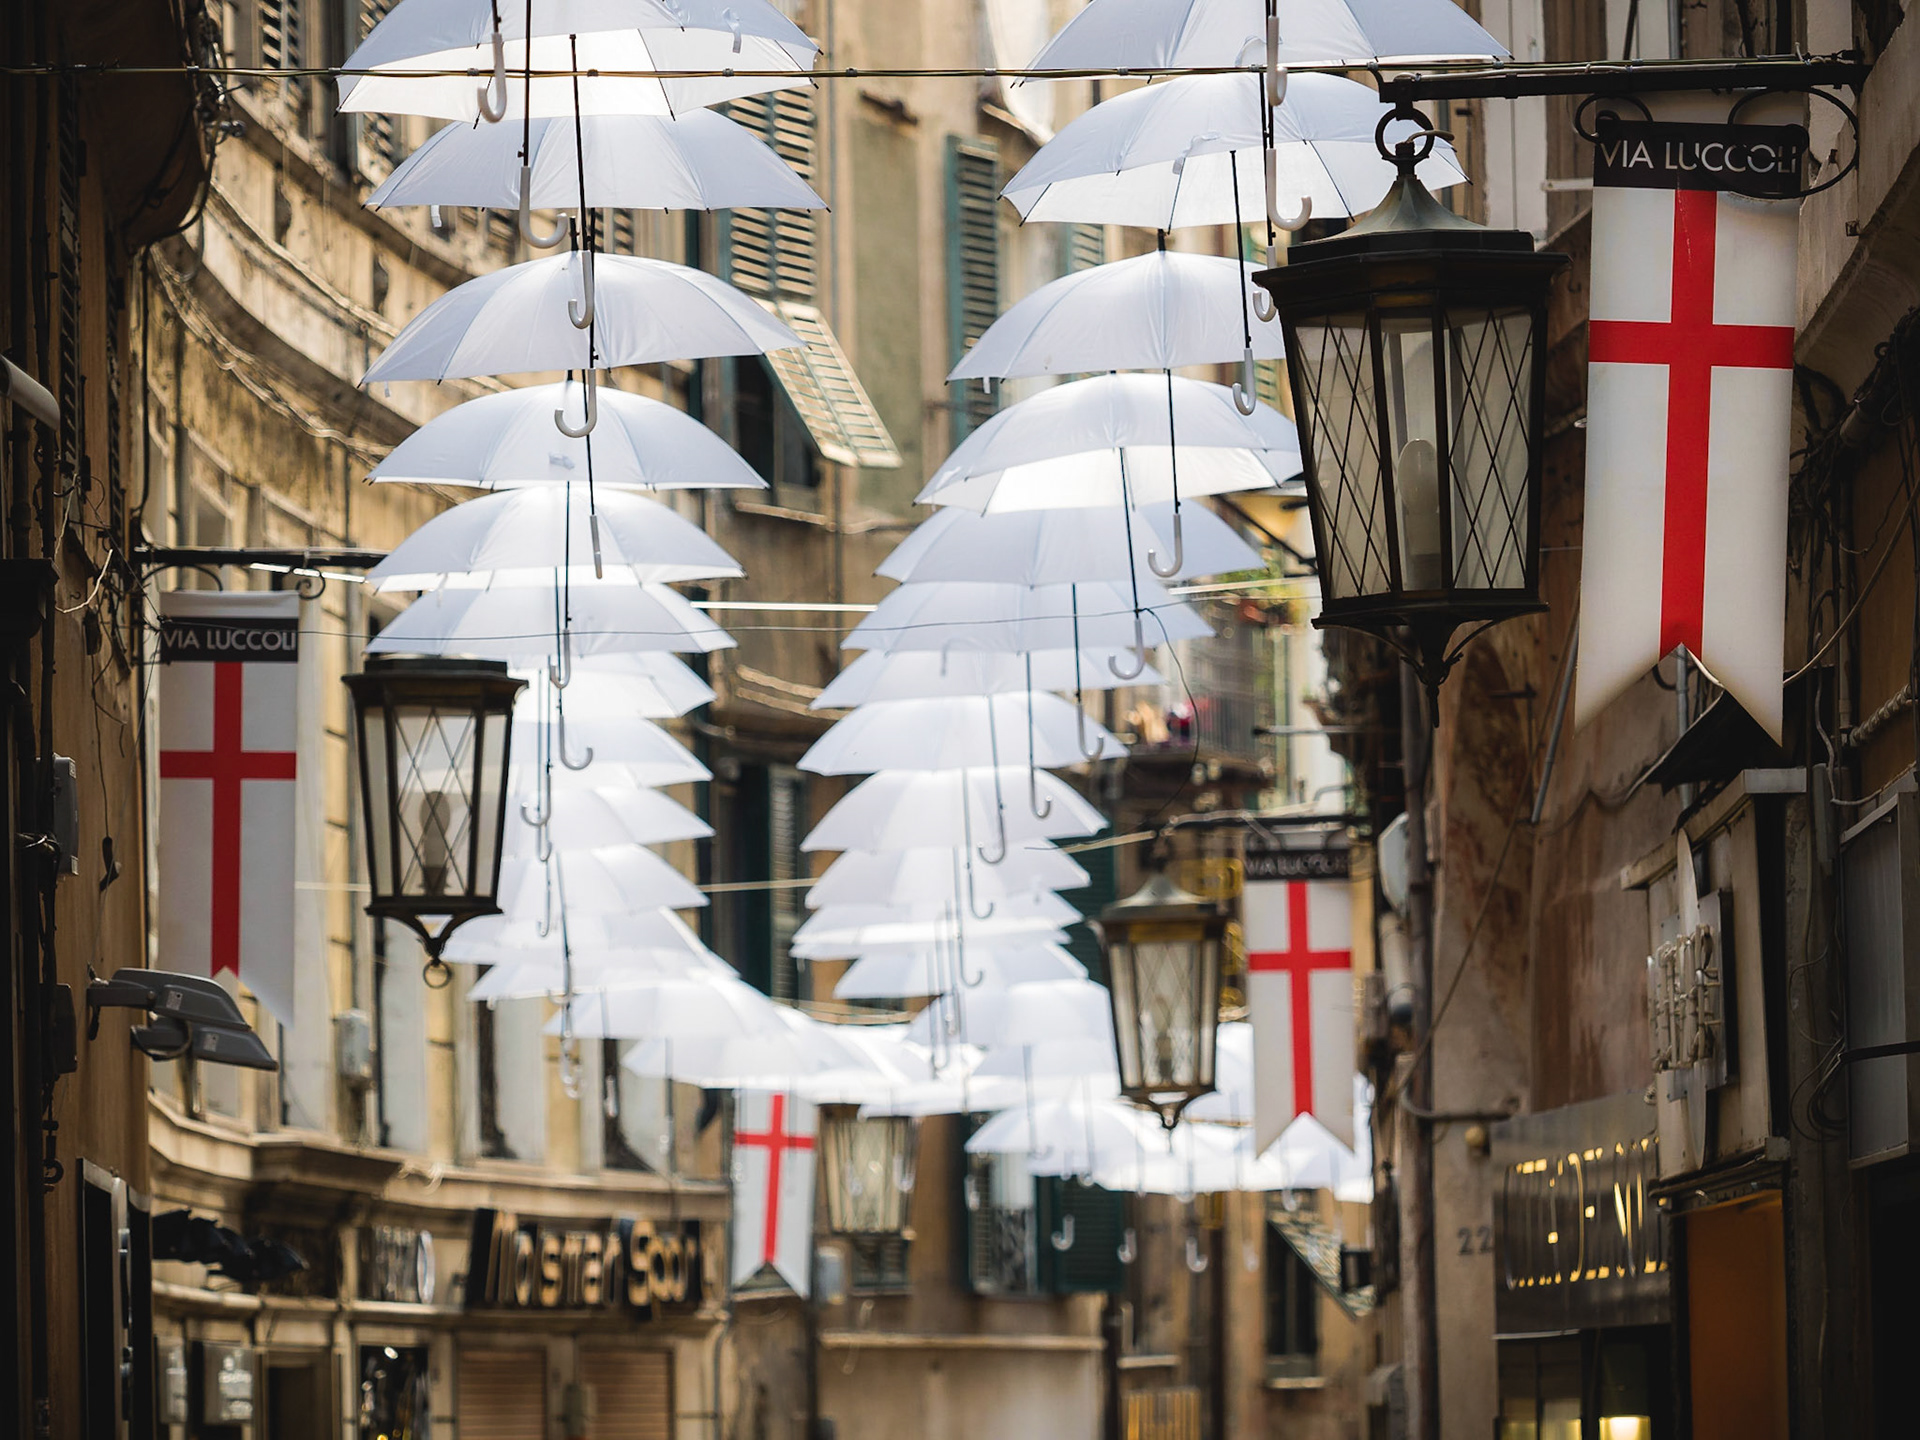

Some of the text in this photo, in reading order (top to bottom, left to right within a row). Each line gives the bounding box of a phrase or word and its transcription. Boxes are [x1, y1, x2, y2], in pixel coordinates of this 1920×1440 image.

[1601, 140, 1797, 173] VIA LUCCOLI
[162, 628, 297, 651] VIA LUCCOLI
[1245, 853, 1348, 876] VIA LUCCO
[1457, 1226, 1494, 1255] 22
